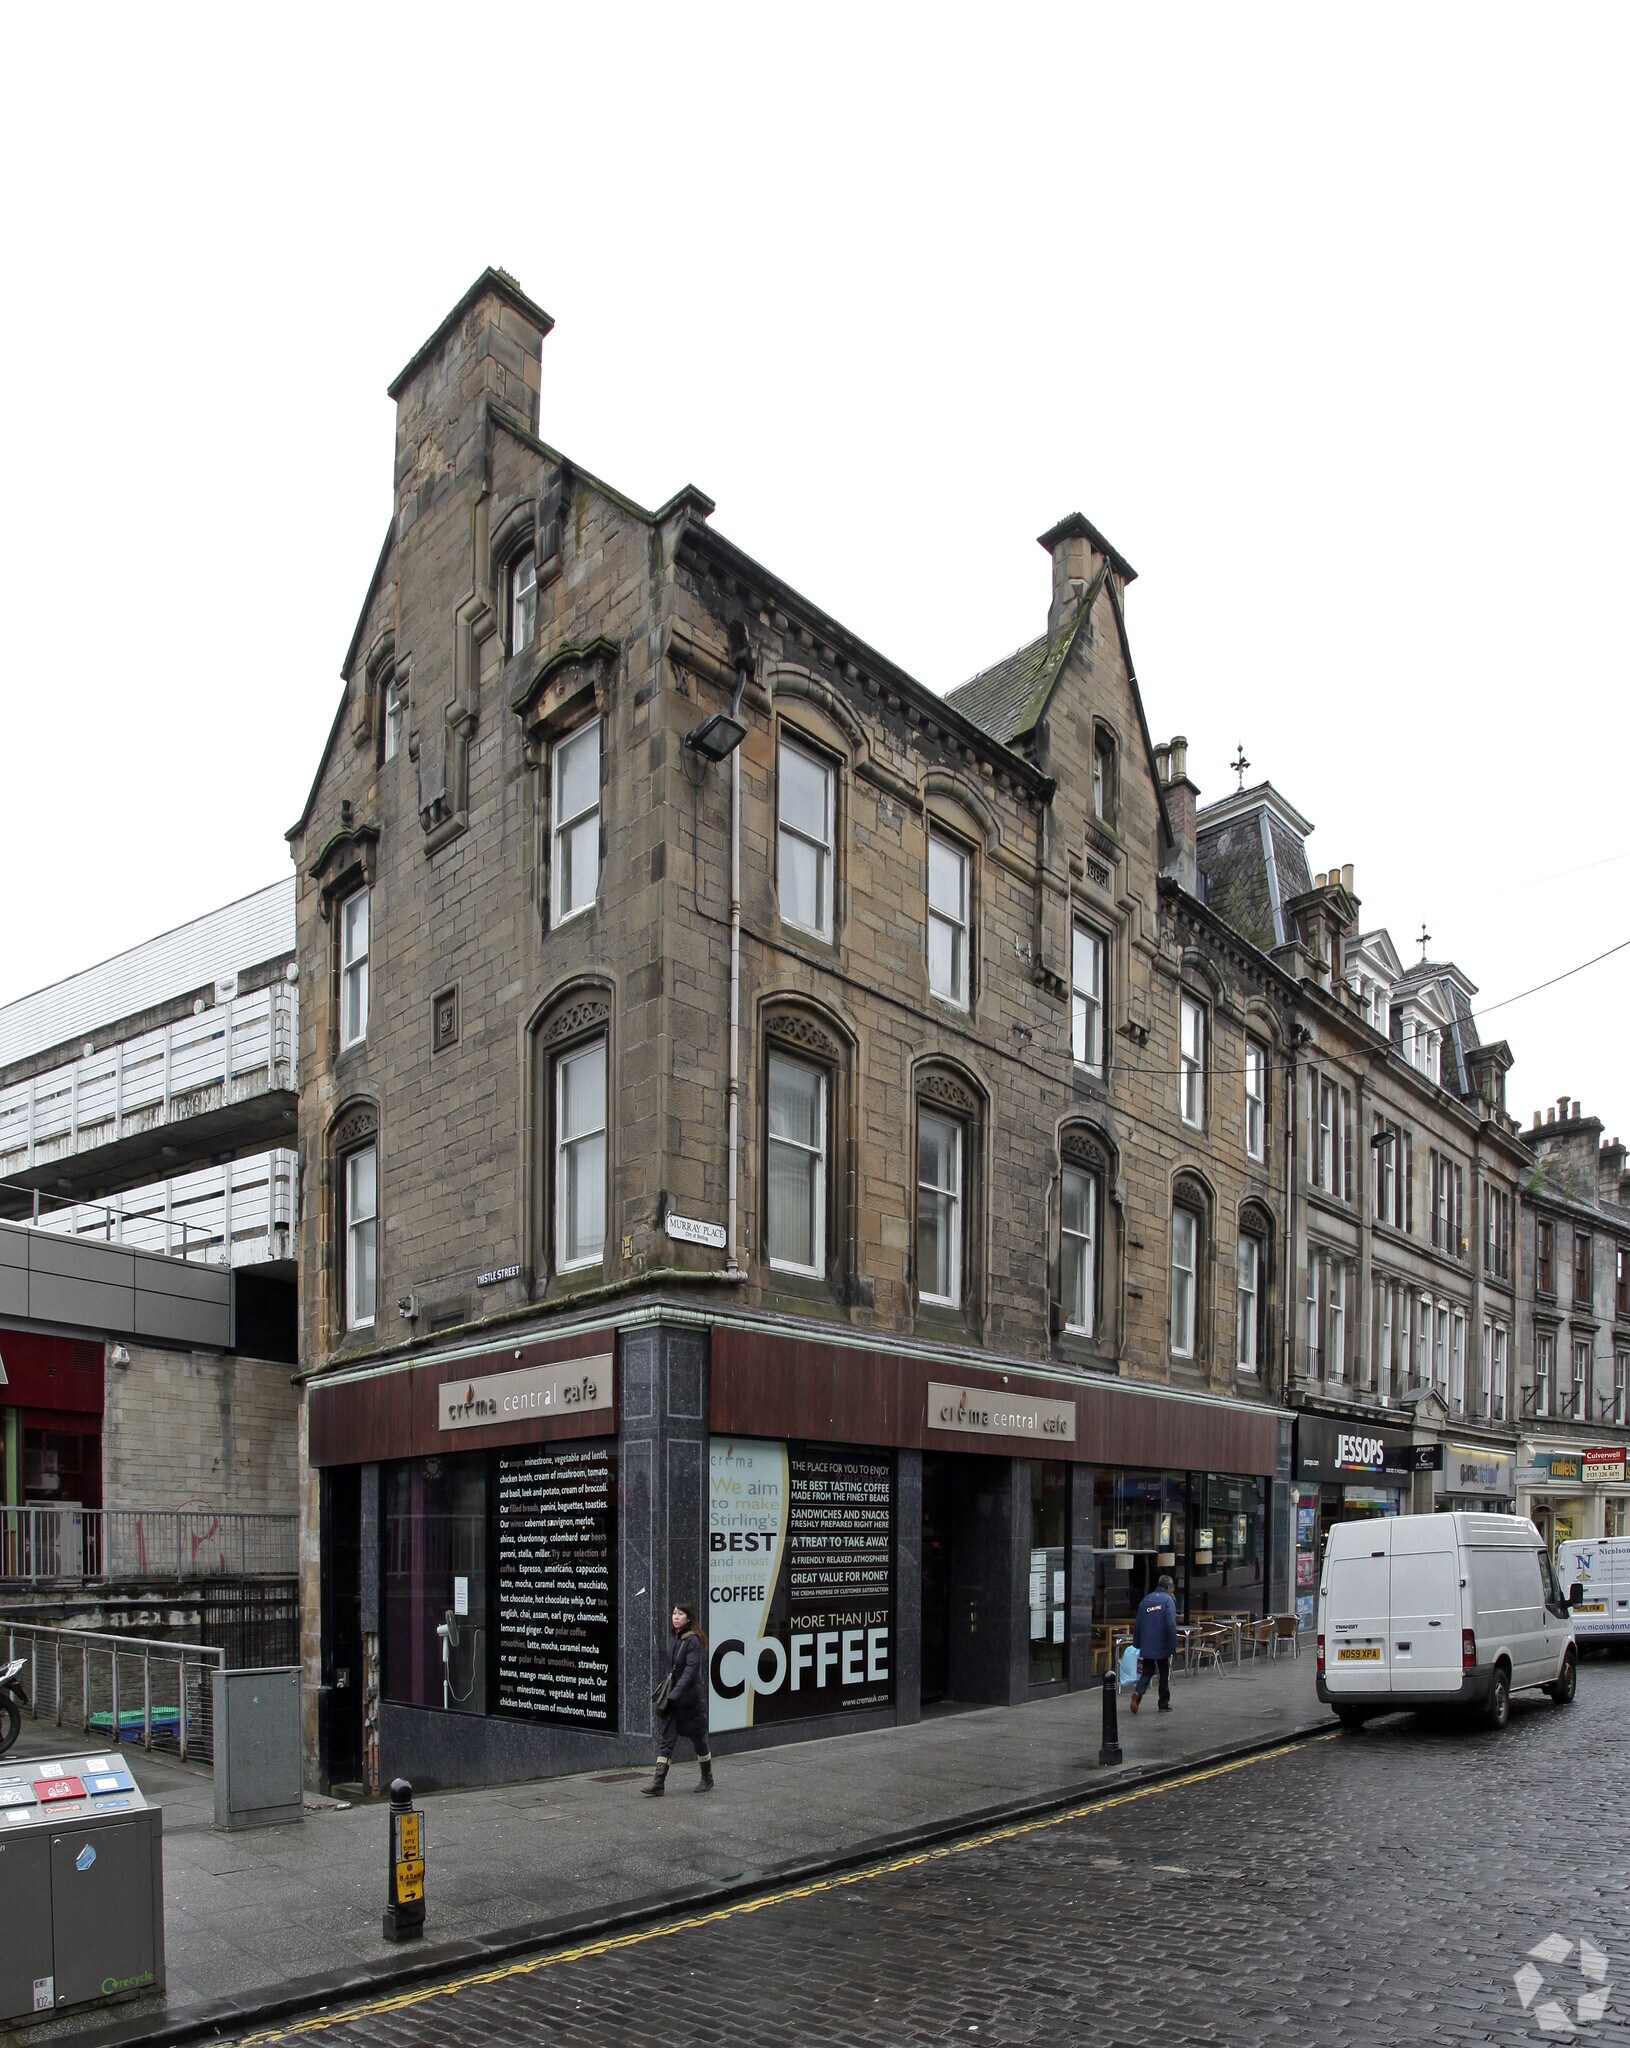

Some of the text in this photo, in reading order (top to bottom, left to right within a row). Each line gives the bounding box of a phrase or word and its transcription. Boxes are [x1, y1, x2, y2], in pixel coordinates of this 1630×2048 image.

[670, 1219, 724, 1238] MURRAY PLACE
[477, 1266, 519, 1284] THISTLE STREET
[504, 1382, 557, 1411] central
[564, 1376, 597, 1404] cafe
[994, 1412, 1038, 1429] central
[1044, 1415, 1067, 1434] cafe
[1335, 1434, 1384, 1468] JESSOPS
[792, 1461, 889, 1477] THE PLACE FOR YOU TO ENJOY
[711, 1477, 778, 1495] We aim
[792, 1480, 889, 1492] THE BEST TASTING COFFEE
[791, 1491, 811, 1500] MADE
[812, 1492, 831, 1500] FROM
[847, 1493, 868, 1501] FINEST
[869, 1494, 889, 1502] BEANS
[500, 1505, 509, 1513] Our
[712, 1499, 780, 1510] to make
[791, 1509, 889, 1519] SANDWICHES AND SNACKS
[500, 1520, 509, 1528] Our
[710, 1512, 778, 1530] Stirling's
[710, 1532, 777, 1552] BEST
[791, 1537, 888, 1547] A TREAT TO TAKE AWAY
[710, 1556, 769, 1567] and most
[798, 1556, 825, 1564] FRIENDLY
[710, 1571, 767, 1583] authentic
[791, 1571, 888, 1583] GREAT VALUE FOR MONEY
[500, 1594, 509, 1602] hot
[535, 1595, 544, 1603] hot
[586, 1596, 596, 1605] Our
[710, 1586, 764, 1603] COFFEE
[791, 1611, 888, 1628] MORE THAN JUST
[517, 1625, 525, 1633] and
[544, 1626, 554, 1634] Our
[1362, 1649, 1376, 1658] XPA
[710, 1628, 888, 1699] COFFEE
[596, 1677, 607, 1686] Our
[120, 1970, 154, 1987] recycle
[36, 1996, 48, 2009] 102
